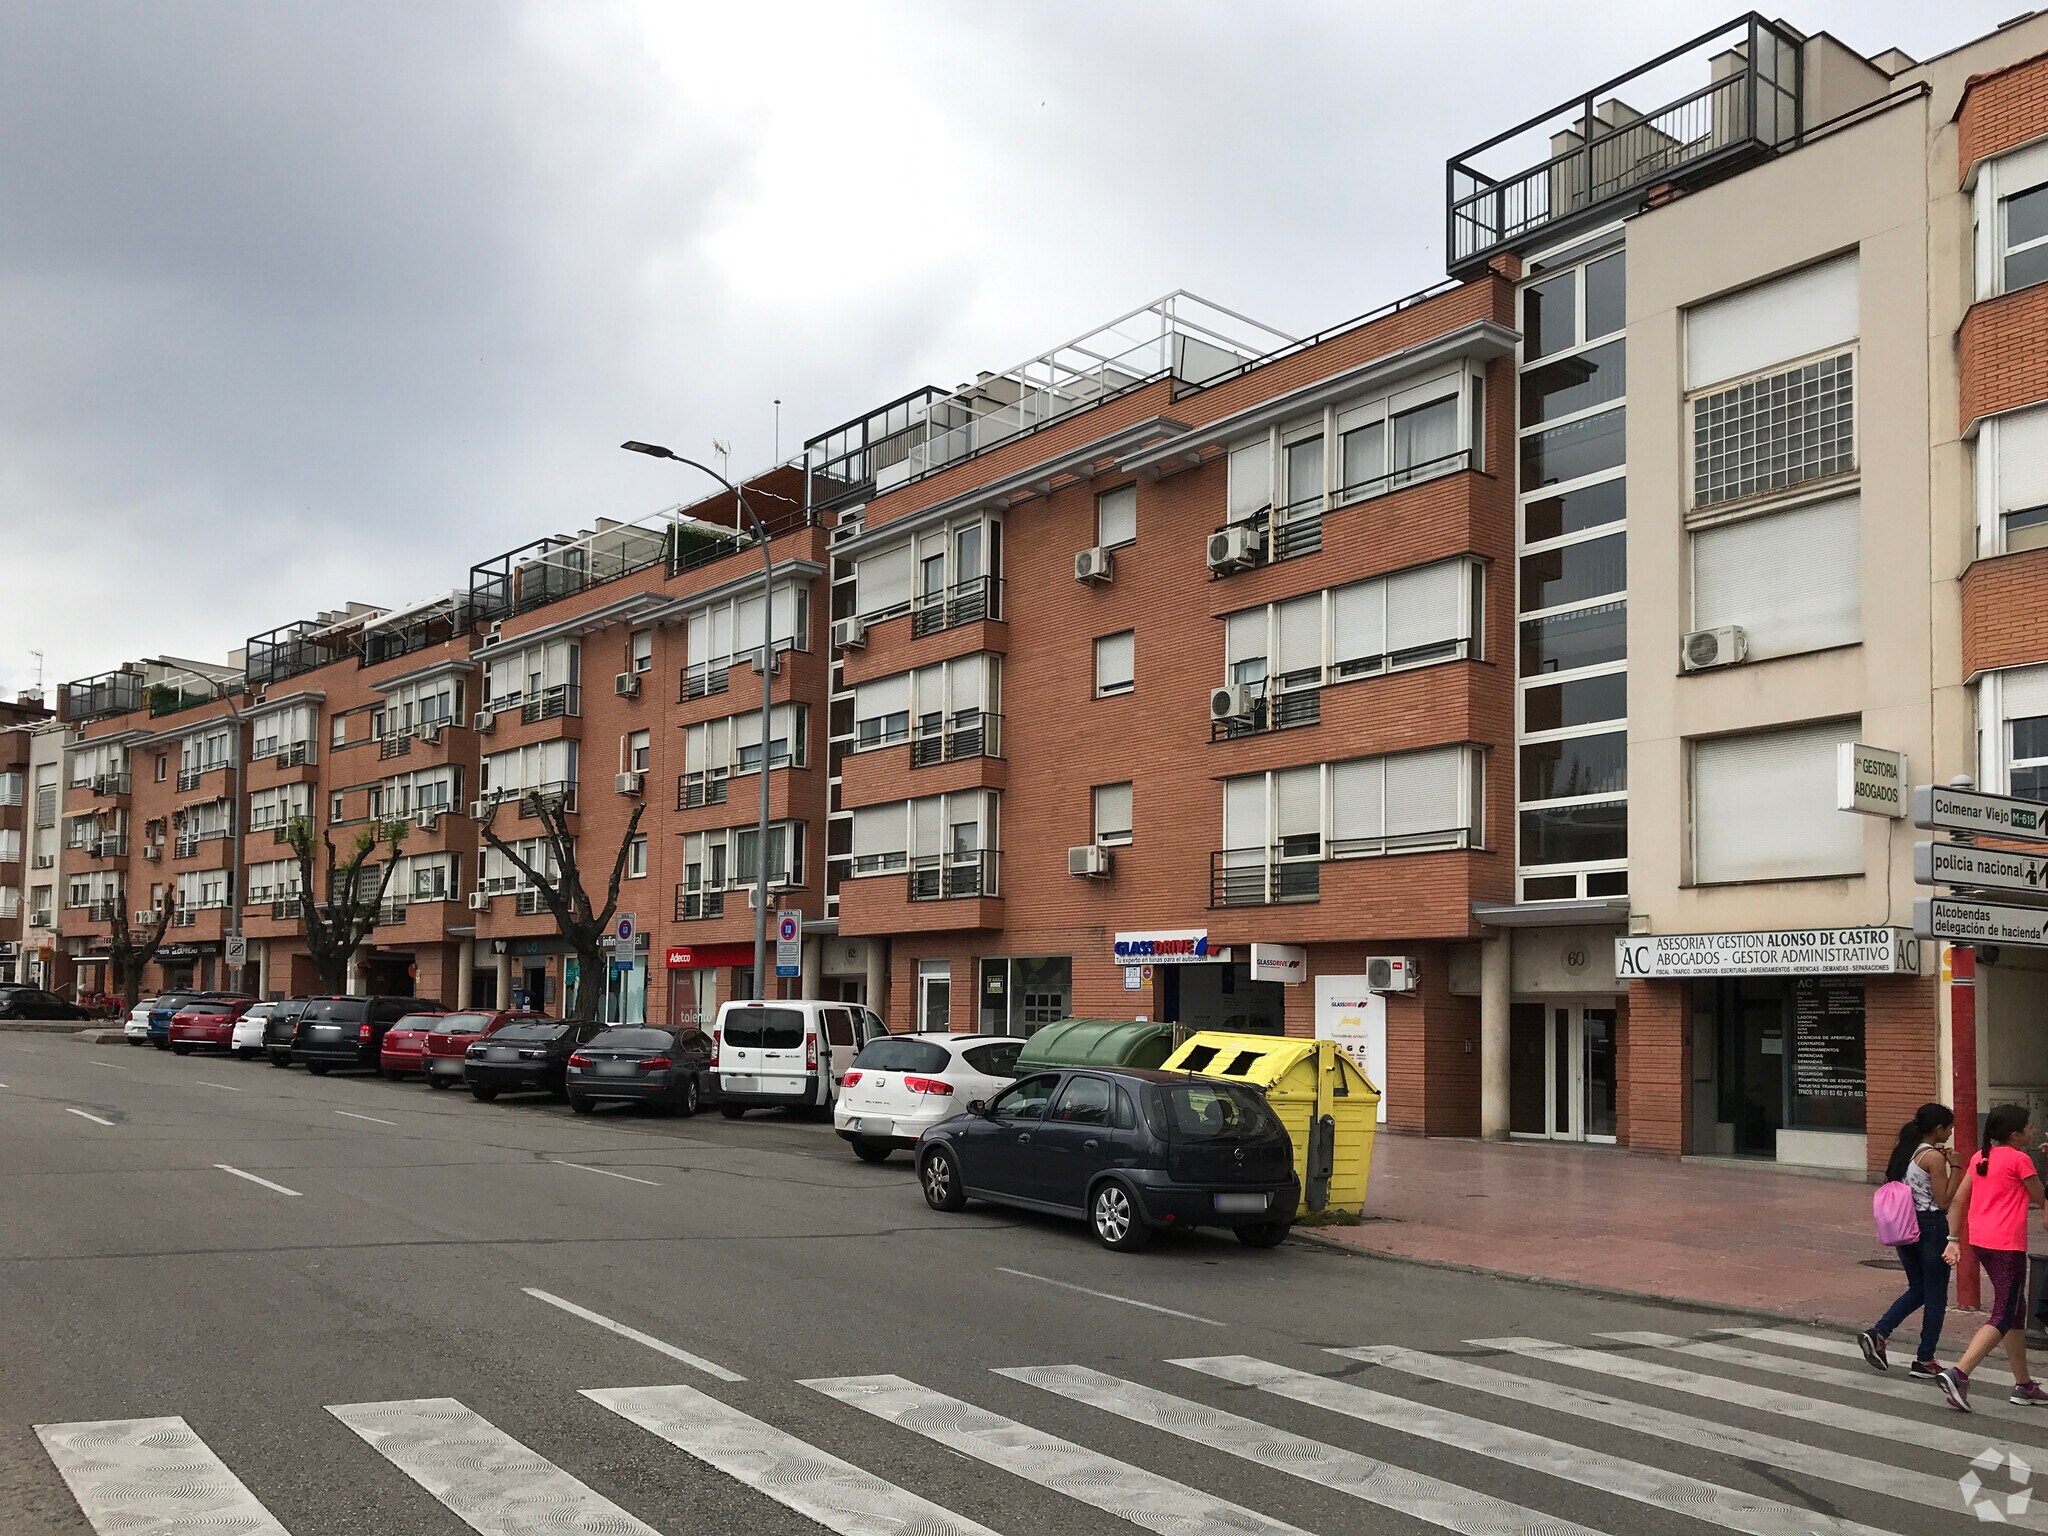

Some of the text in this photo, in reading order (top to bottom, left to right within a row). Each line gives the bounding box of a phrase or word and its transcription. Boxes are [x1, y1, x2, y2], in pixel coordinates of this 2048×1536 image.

[1862, 758, 1898, 779] GESTORIA
[1854, 781, 1898, 803] ABOGADOS
[1935, 799, 2010, 824] Colmenar Viejo
[2012, 812, 2035, 826] M-616
[1935, 855, 2024, 878] policia nacional
[1935, 904, 1991, 921] Alcobendas
[1935, 919, 2041, 939] delegación de hacienda
[1114, 939, 1195, 956] GLASSDRIVE
[1656, 930, 1889, 951] ASESORIA Y GESTION ALONSO DE CASTRO
[670, 952, 691, 963] Adecco
[848, 948, 856, 958] 62
[1567, 951, 1585, 966] 60
[1620, 946, 1651, 974] AC
[1656, 951, 1720, 966] ABOGADOS
[1732, 949, 1778, 964] GESTOR
[1781, 947, 1890, 963] ADMINISTRATIVO
[1896, 939, 1918, 971] AC
[1257, 958, 1288, 967] GLASSDRIVE
[1797, 979, 1813, 988] AC
[524, 996, 530, 1004] P
[680, 1009, 712, 1023] talento
